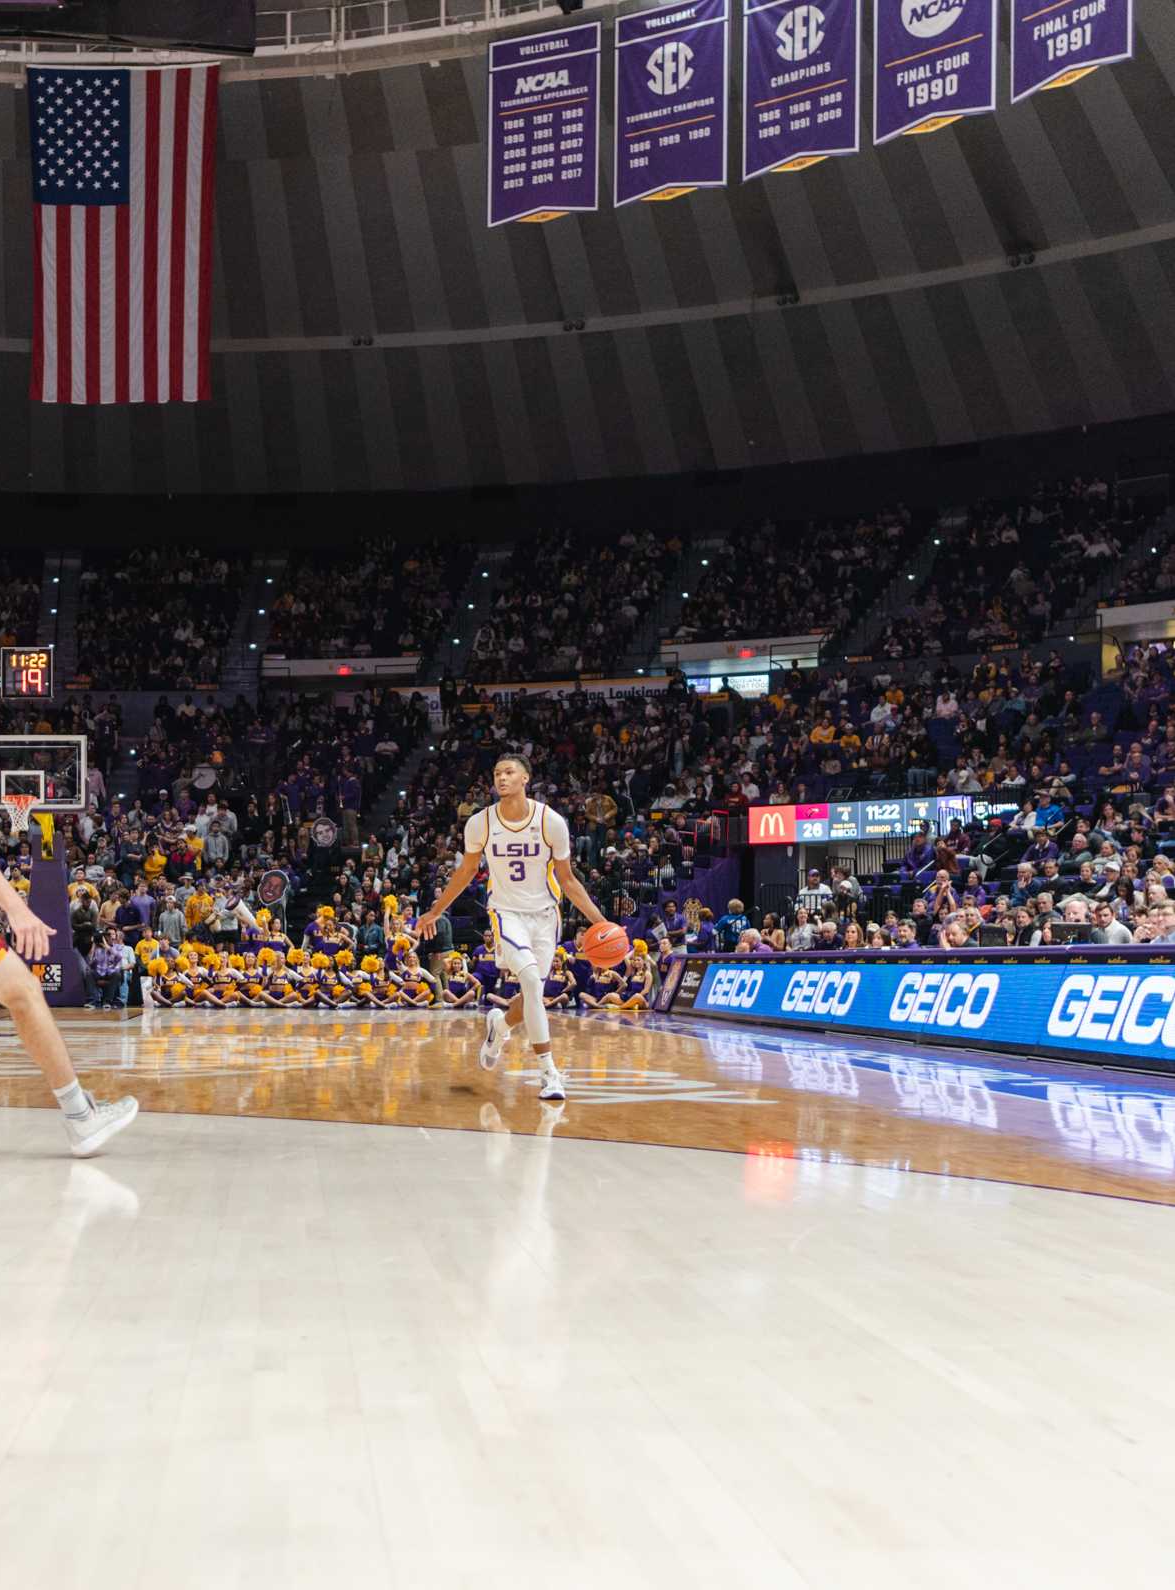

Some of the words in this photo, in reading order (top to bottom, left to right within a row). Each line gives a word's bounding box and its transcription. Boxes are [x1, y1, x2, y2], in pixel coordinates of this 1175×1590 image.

[645, 8, 696, 30] VOLLEYBALL
[1033, 14, 1068, 40] FINAL
[1072, 0, 1105, 24] FOUR
[776, 5, 825, 61] SEC
[1047, 22, 1092, 61] 1991
[519, 38, 569, 56] VOLLEYBALL
[646, 41, 694, 95] SEC
[770, 61, 831, 88] CHAMPIONS
[896, 64, 932, 86] FINAL
[936, 51, 970, 74] FOUR
[514, 68, 569, 95] NCAA
[907, 73, 958, 108] 1990
[543, 86, 589, 100] APPEARANCES
[626, 106, 672, 124] TOURNAMENT
[673, 96, 715, 113] CHAMPIONS
[534, 128, 552, 140] 1991
[689, 127, 711, 140] 1990
[759, 125, 781, 139] 1990
[790, 117, 810, 131] 1991
[817, 108, 842, 123] 2009
[560, 138, 583, 150] 2007
[561, 153, 583, 165] 2010
[630, 157, 648, 168] 1991
[504, 178, 523, 190] 2013
[561, 168, 582, 180] 2017
[10, 653, 48, 668] 11:22
[21, 668, 42, 693] 19
[866, 803, 900, 820] 11:22
[803, 822, 823, 838] 26
[866, 824, 891, 834] PERIOD
[895, 823, 902, 833] 2
[492, 843, 540, 857] LSU
[509, 860, 526, 882] 3
[707, 968, 764, 1009] GEICO
[780, 970, 861, 1017] GEICO
[889, 971, 1000, 1030] GEICO
